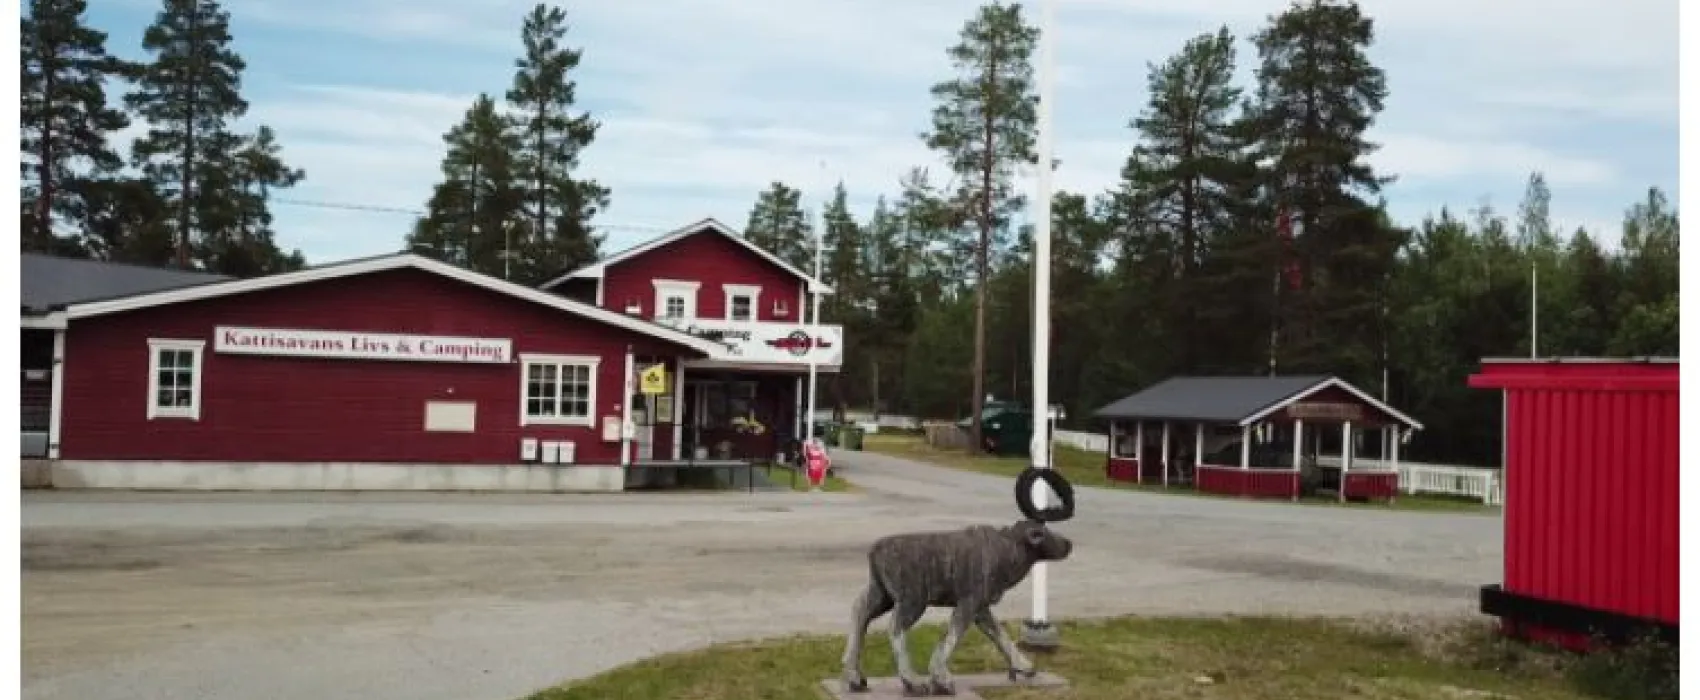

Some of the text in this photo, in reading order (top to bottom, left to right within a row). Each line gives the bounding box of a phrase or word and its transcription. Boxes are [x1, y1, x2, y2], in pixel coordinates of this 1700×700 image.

[225, 330, 503, 361] Kattisavans Livs & Camping
